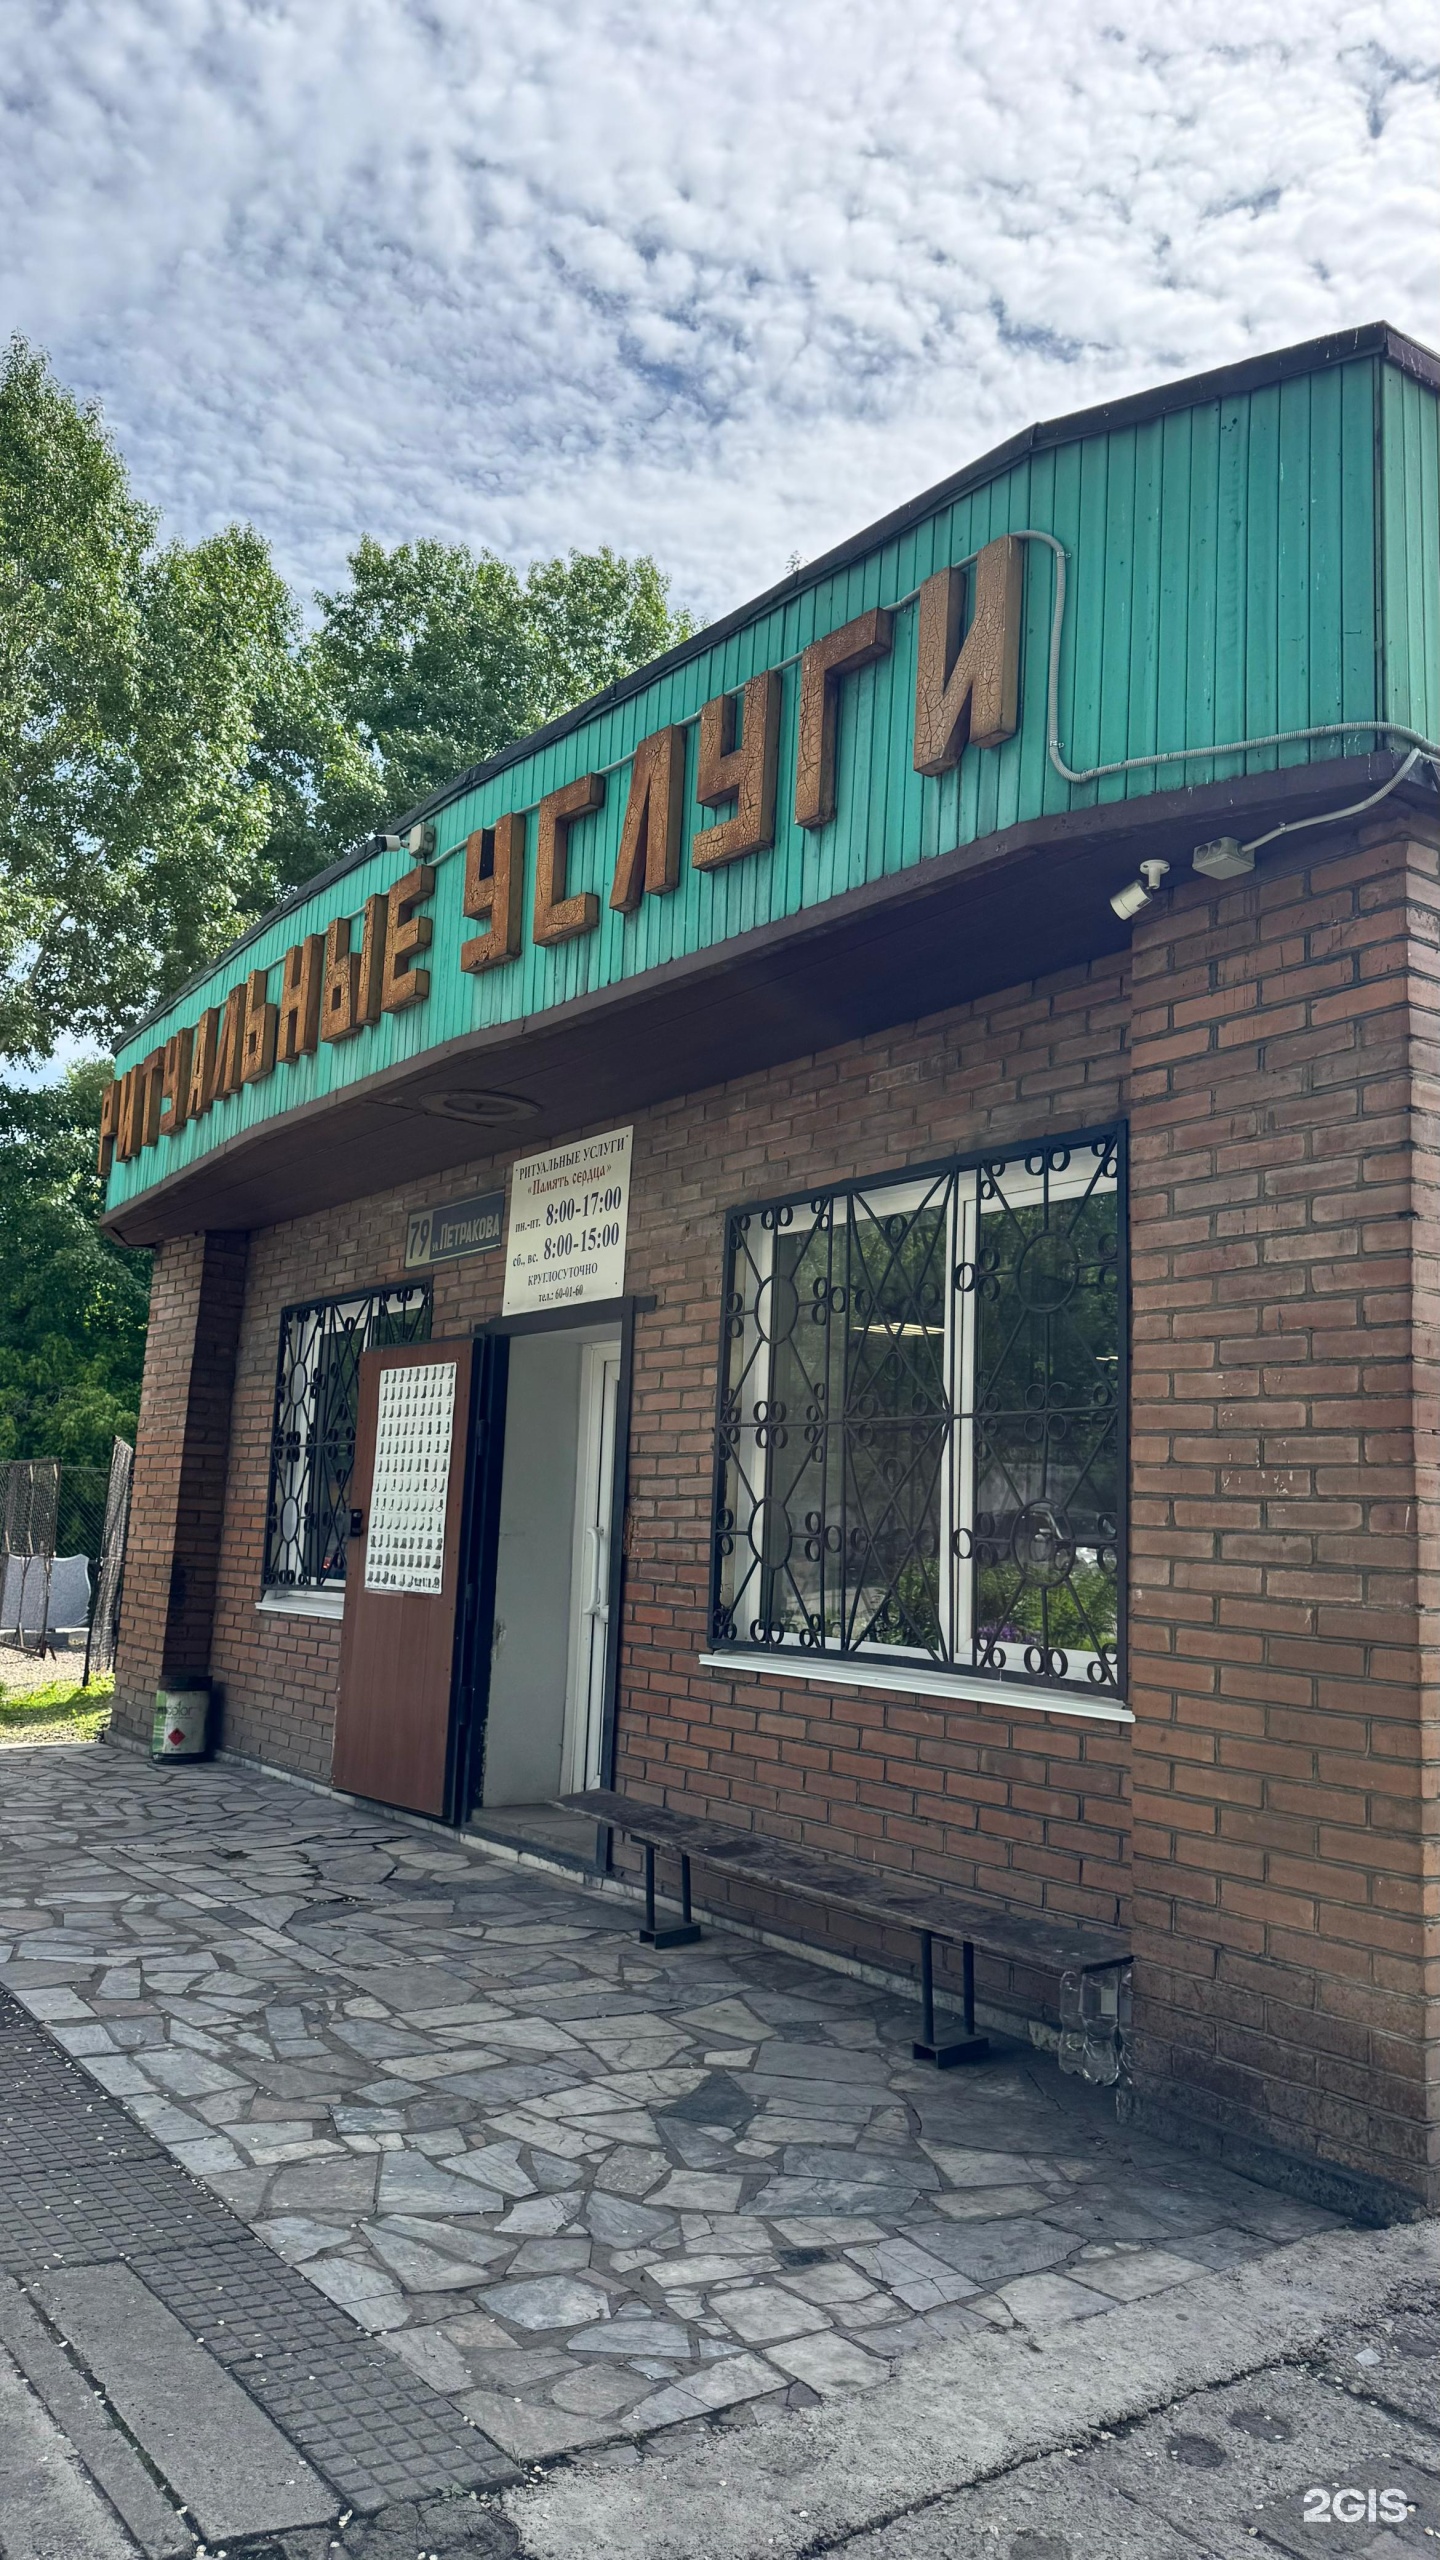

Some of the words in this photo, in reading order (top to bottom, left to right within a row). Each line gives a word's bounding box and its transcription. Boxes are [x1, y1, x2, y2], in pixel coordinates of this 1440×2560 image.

[98, 864, 435, 1176] РИТУАЛЬНЫЕ
[460, 533, 1024, 975] УСЛУГИ
[519, 1150, 581, 1181] РИТУАЛЬНЫЕ
[583, 1137, 625, 1161] УСЛУГИ
[527, 1176, 570, 1196] «Память
[572, 1163, 612, 1187] сердца»
[515, 1218, 541, 1233] пн.-пт.
[545, 1186, 622, 1226] 8:00-17:00
[410, 1218, 430, 1260] 79
[440, 1213, 500, 1251] ПЕТРАКОВА
[527, 1253, 539, 1265] вс.
[543, 1222, 620, 1260] 8:00-15:00
[527, 1262, 598, 1287] КРУГЛОСУТОЧНО
